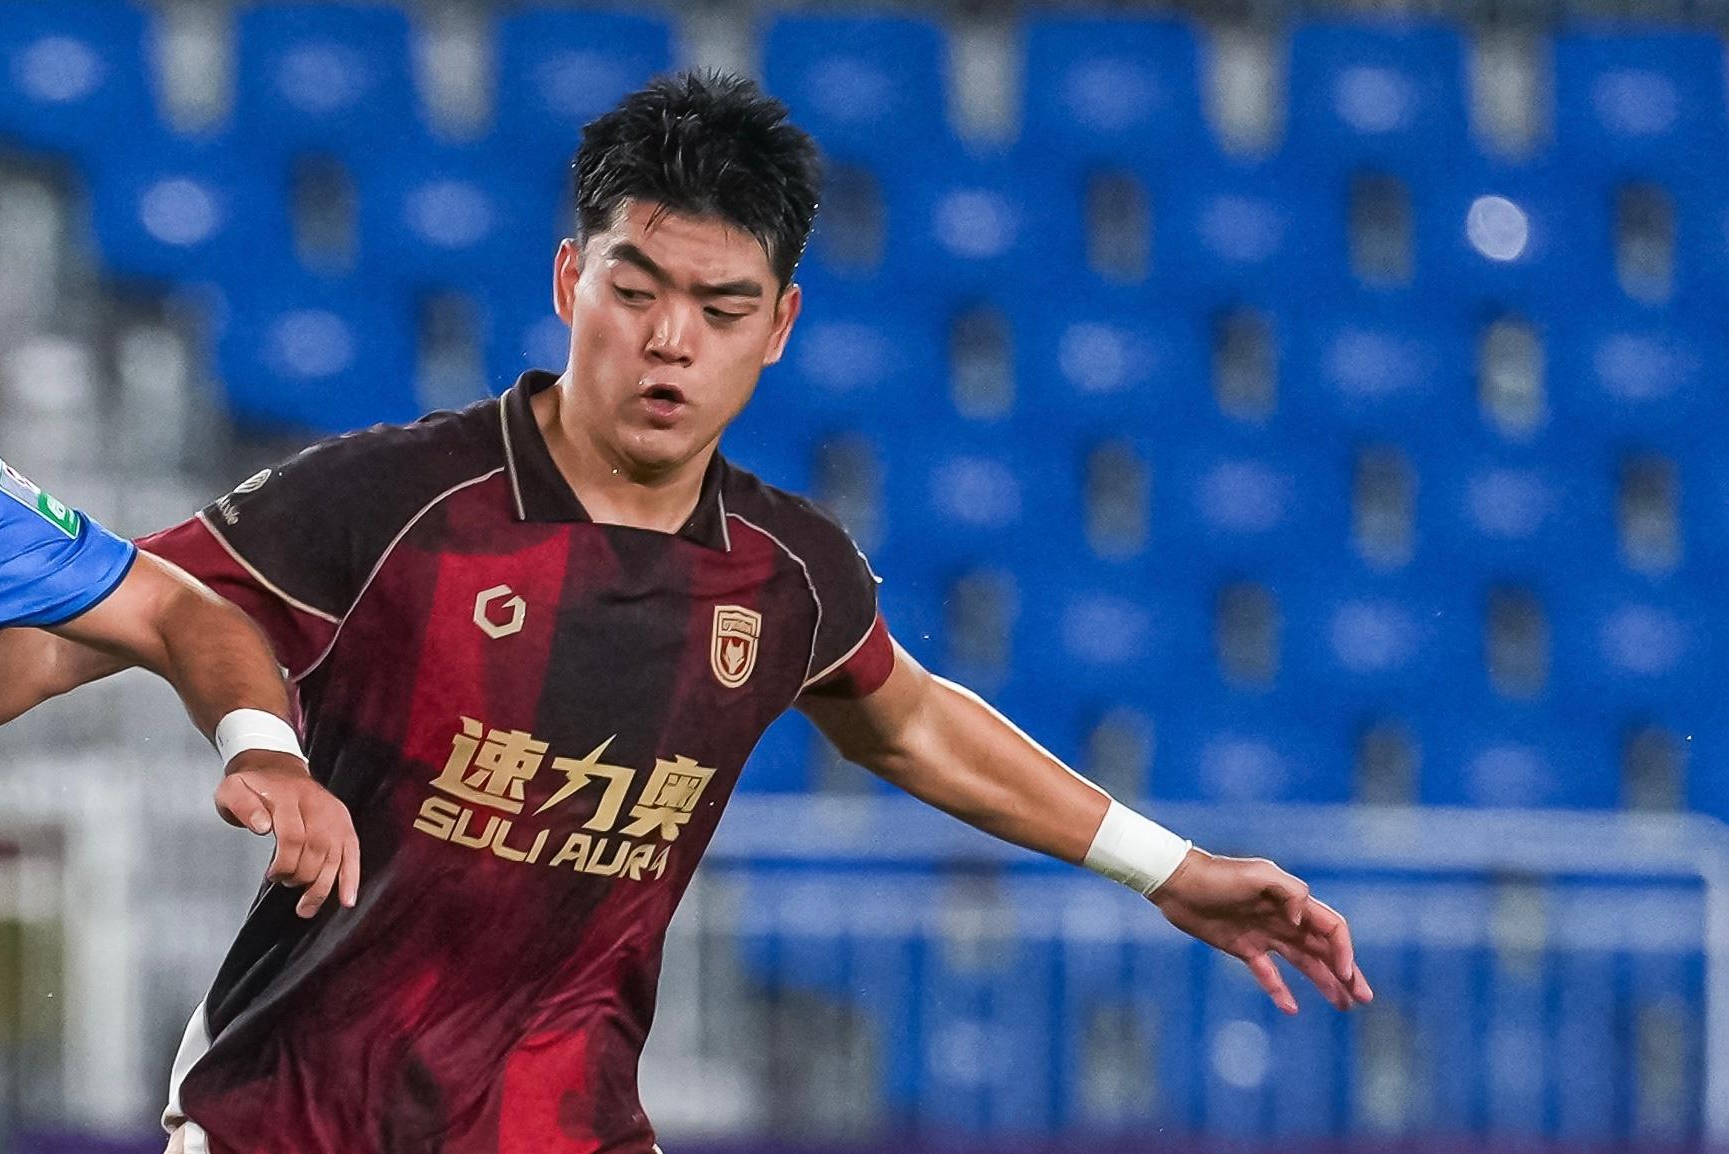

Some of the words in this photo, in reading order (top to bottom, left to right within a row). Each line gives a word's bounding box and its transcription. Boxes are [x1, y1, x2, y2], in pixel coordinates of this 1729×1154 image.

[429, 715, 717, 841] 速力奥
[413, 795, 550, 864] SULI
